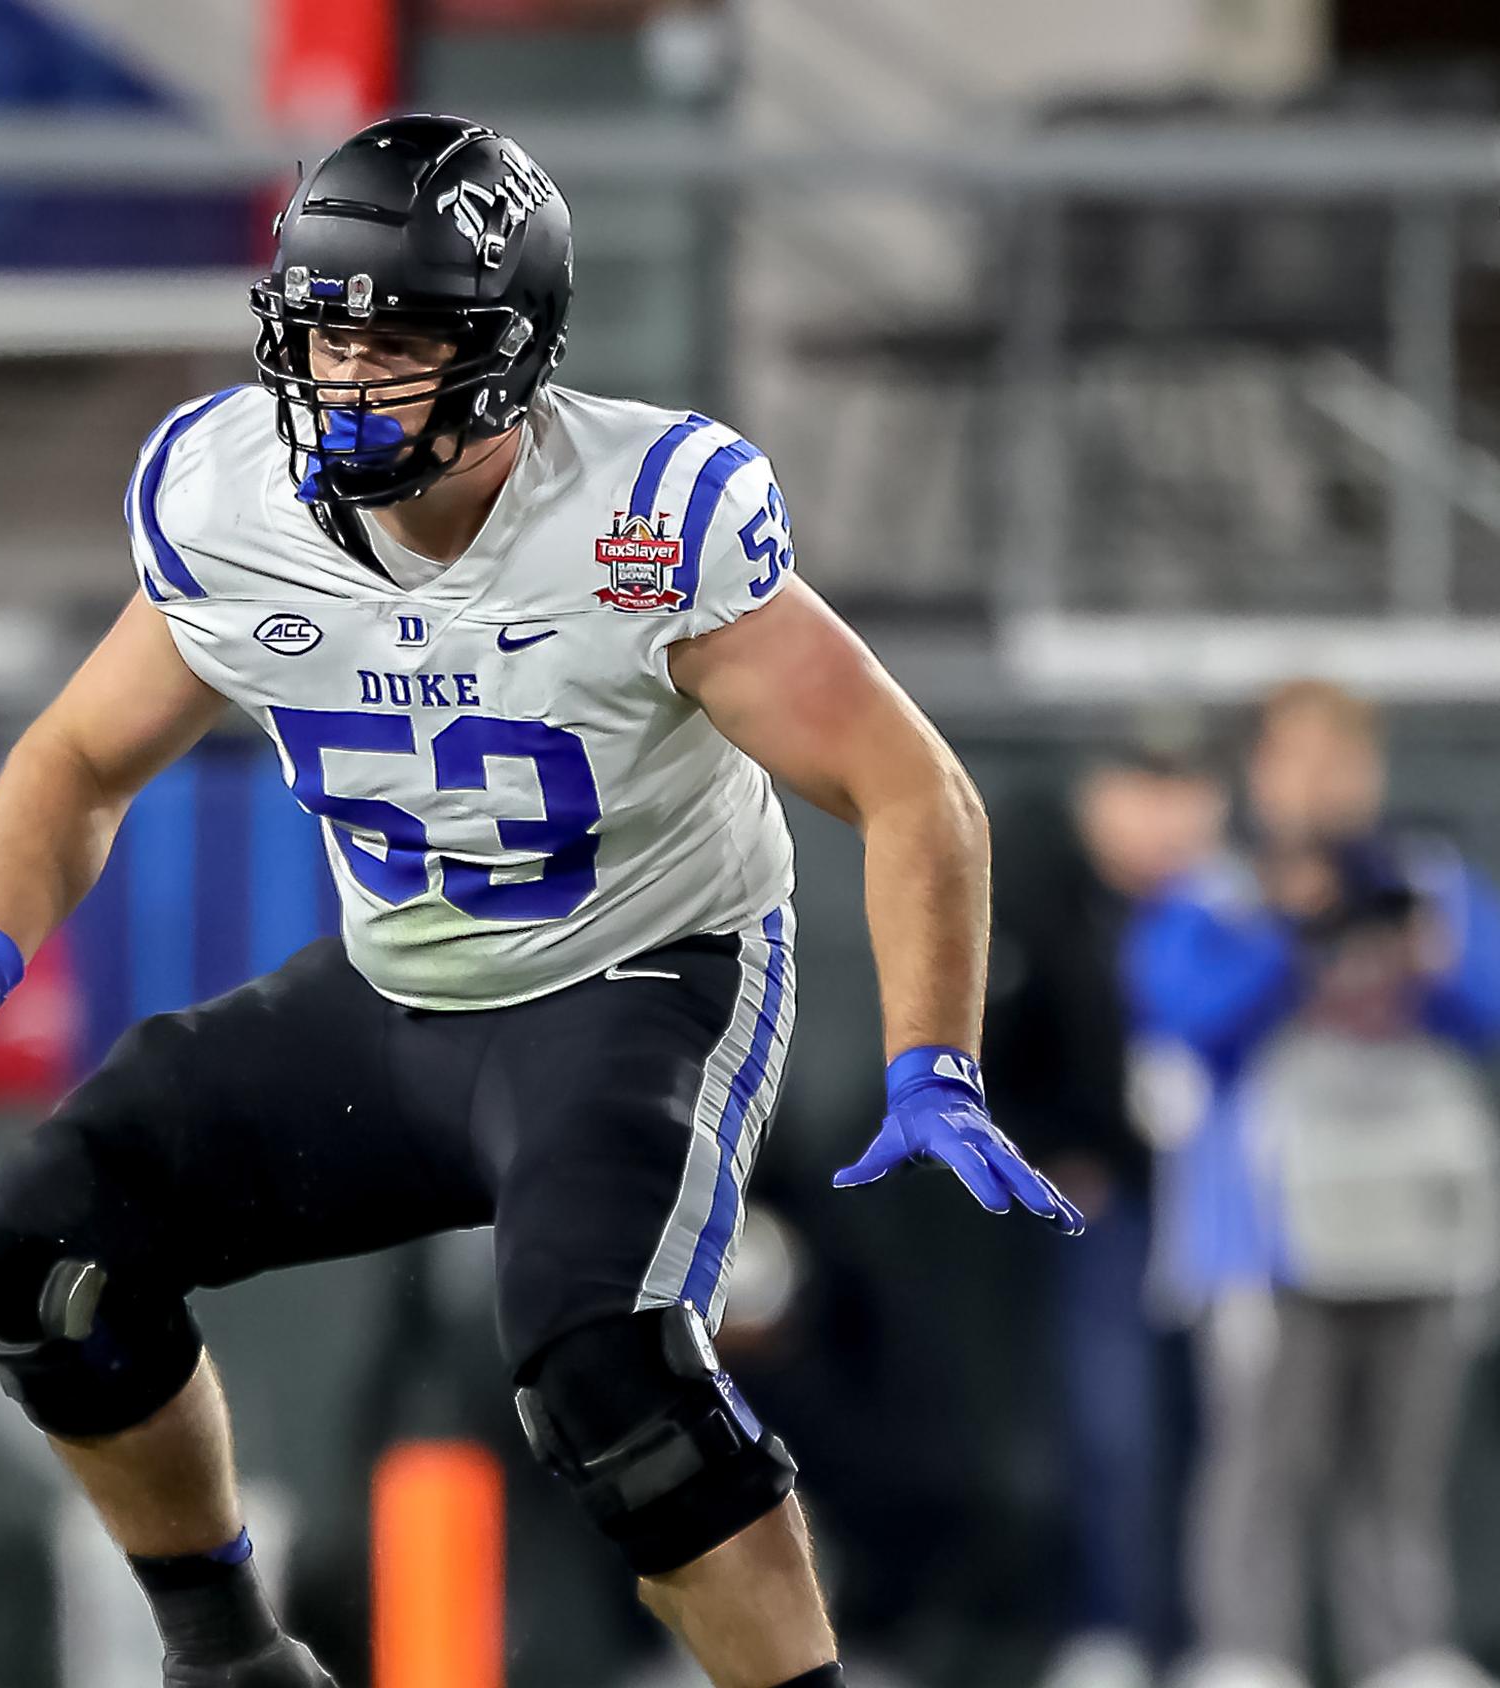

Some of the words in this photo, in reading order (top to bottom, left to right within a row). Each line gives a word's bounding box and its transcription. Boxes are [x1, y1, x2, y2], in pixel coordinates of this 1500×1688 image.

[599, 542, 676, 561] TaxSlayer
[264, 623, 311, 640] ACC
[399, 615, 426, 645] D
[357, 670, 480, 706] DUKE
[268, 706, 603, 921] 53
